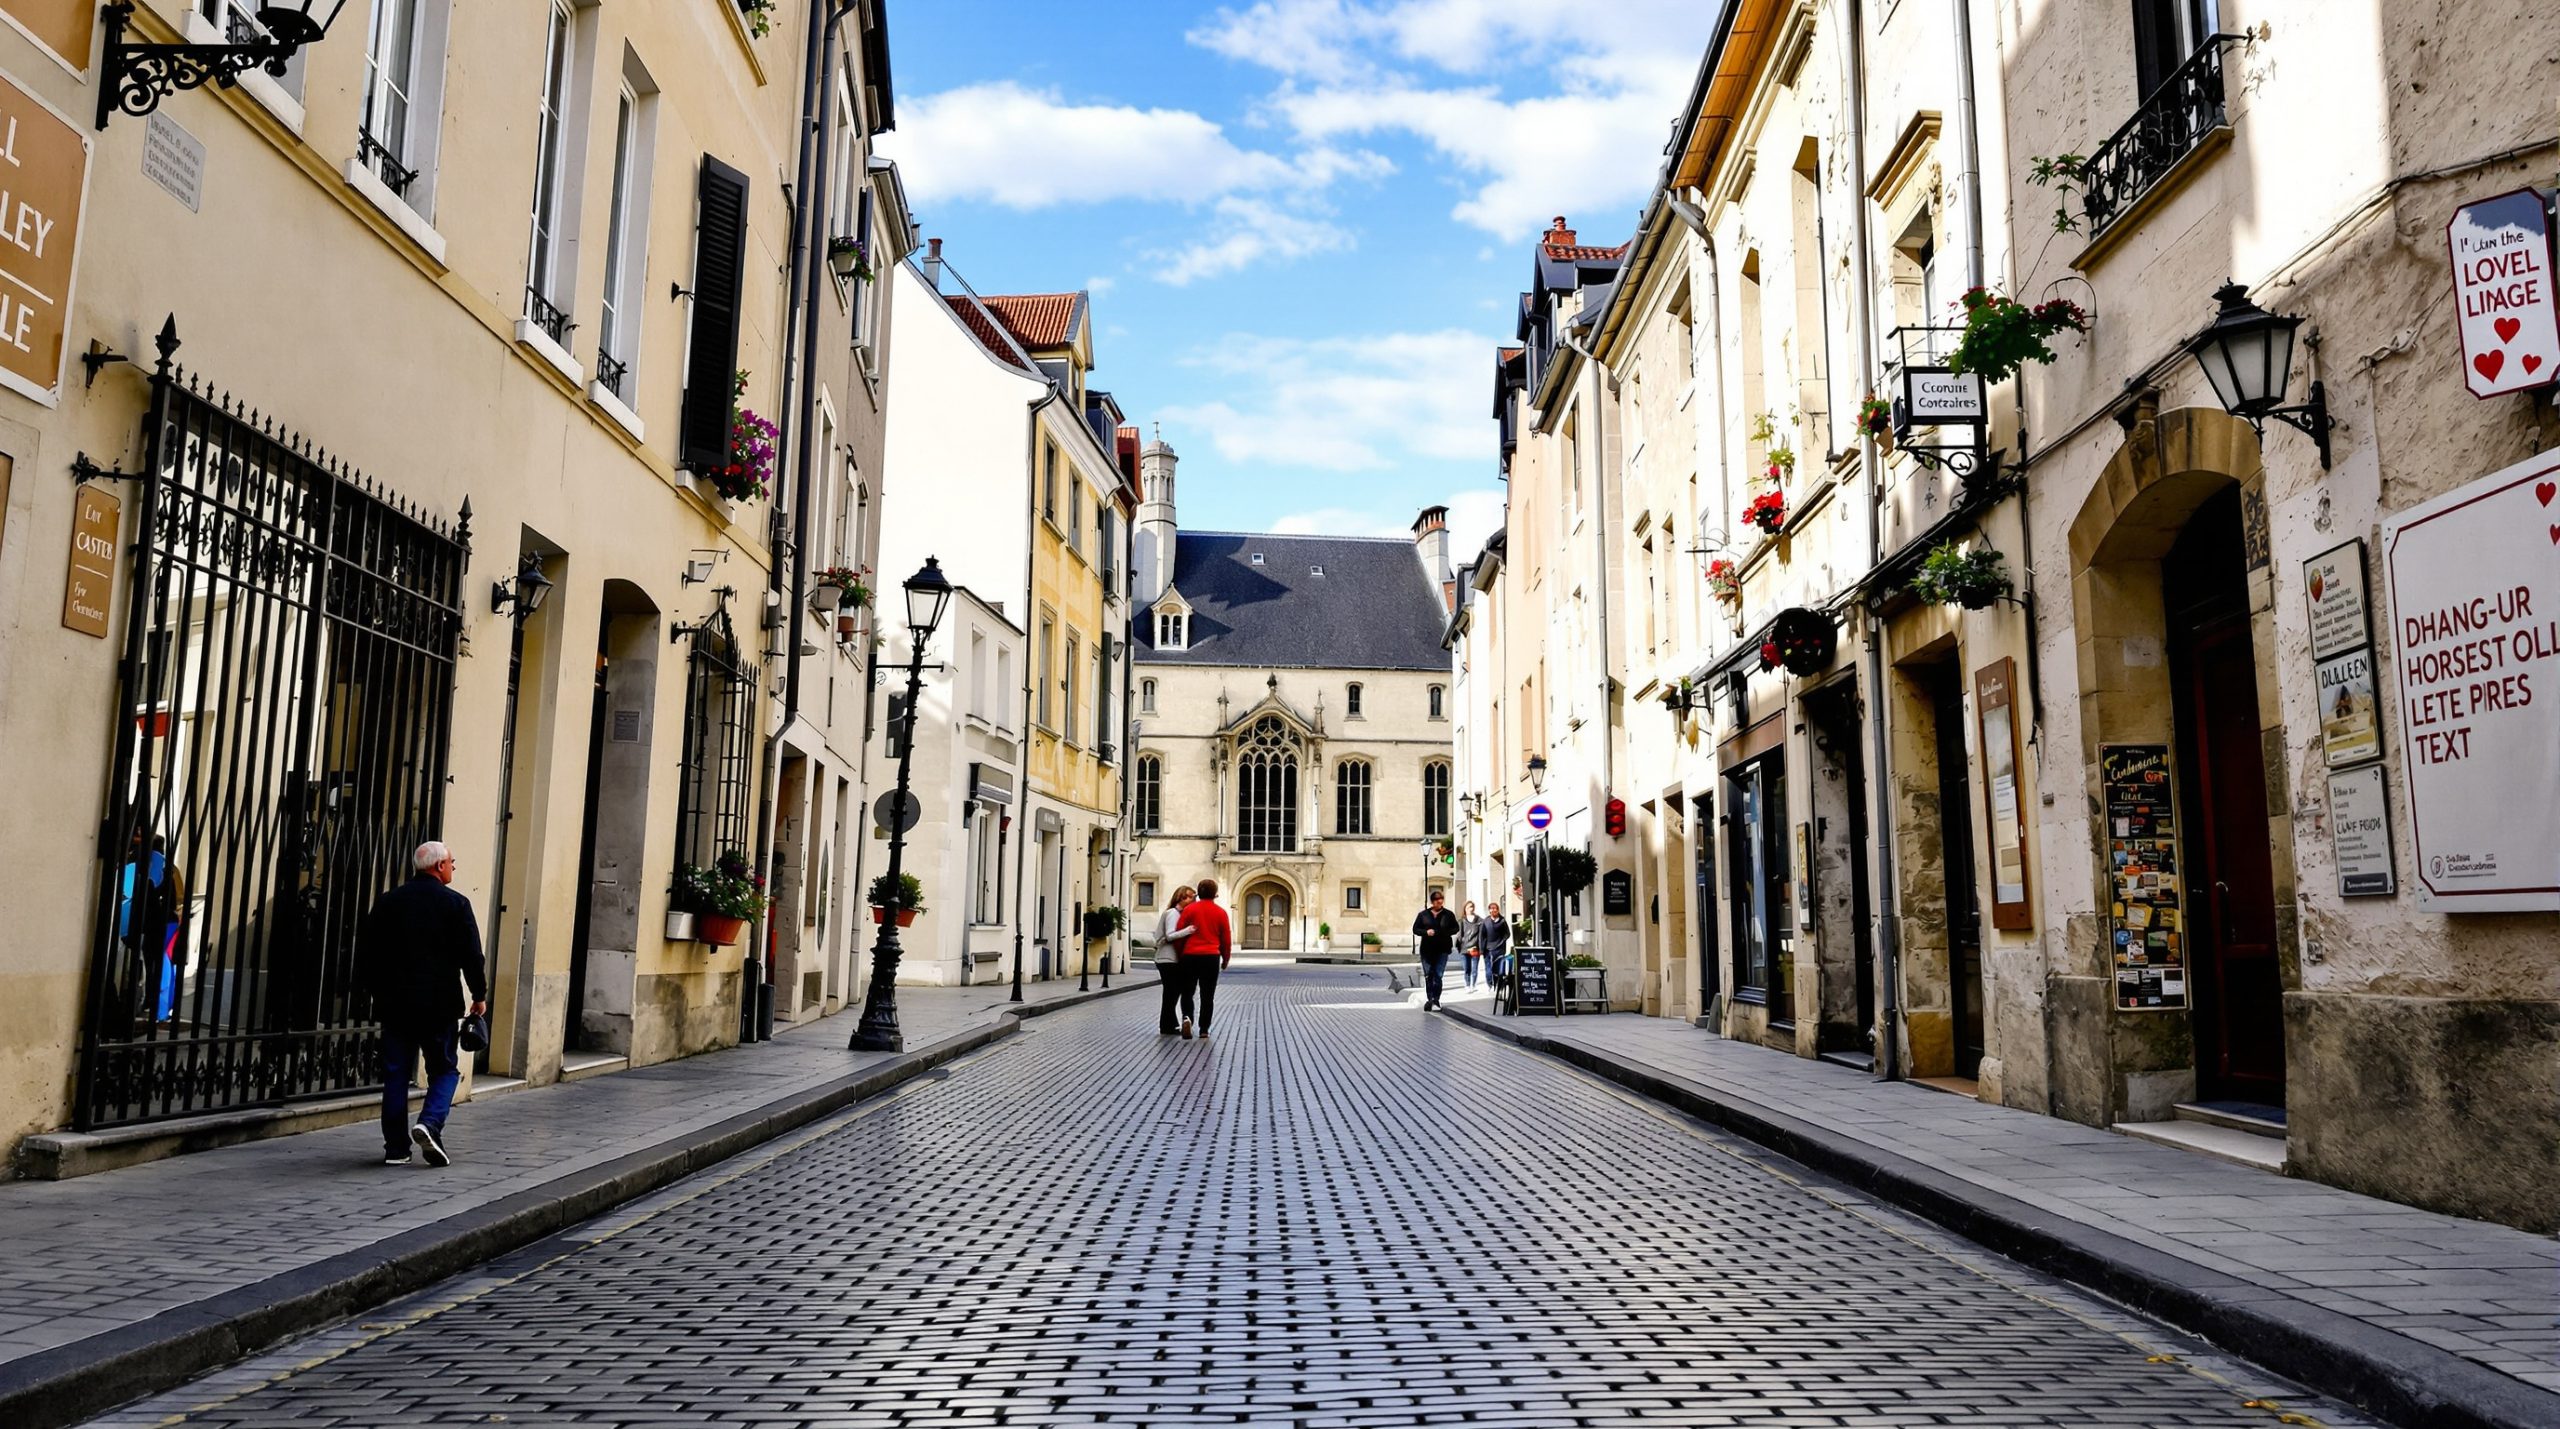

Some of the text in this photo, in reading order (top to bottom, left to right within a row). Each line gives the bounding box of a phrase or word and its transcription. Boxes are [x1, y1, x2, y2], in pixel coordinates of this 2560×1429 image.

[2464, 249, 2540, 287] LOVEL
[2405, 585, 2533, 648] DHANG-UR
[2407, 634, 2507, 687] HORSEST
[2411, 687, 2465, 727] LETE
[2415, 727, 2471, 765] TEXT
